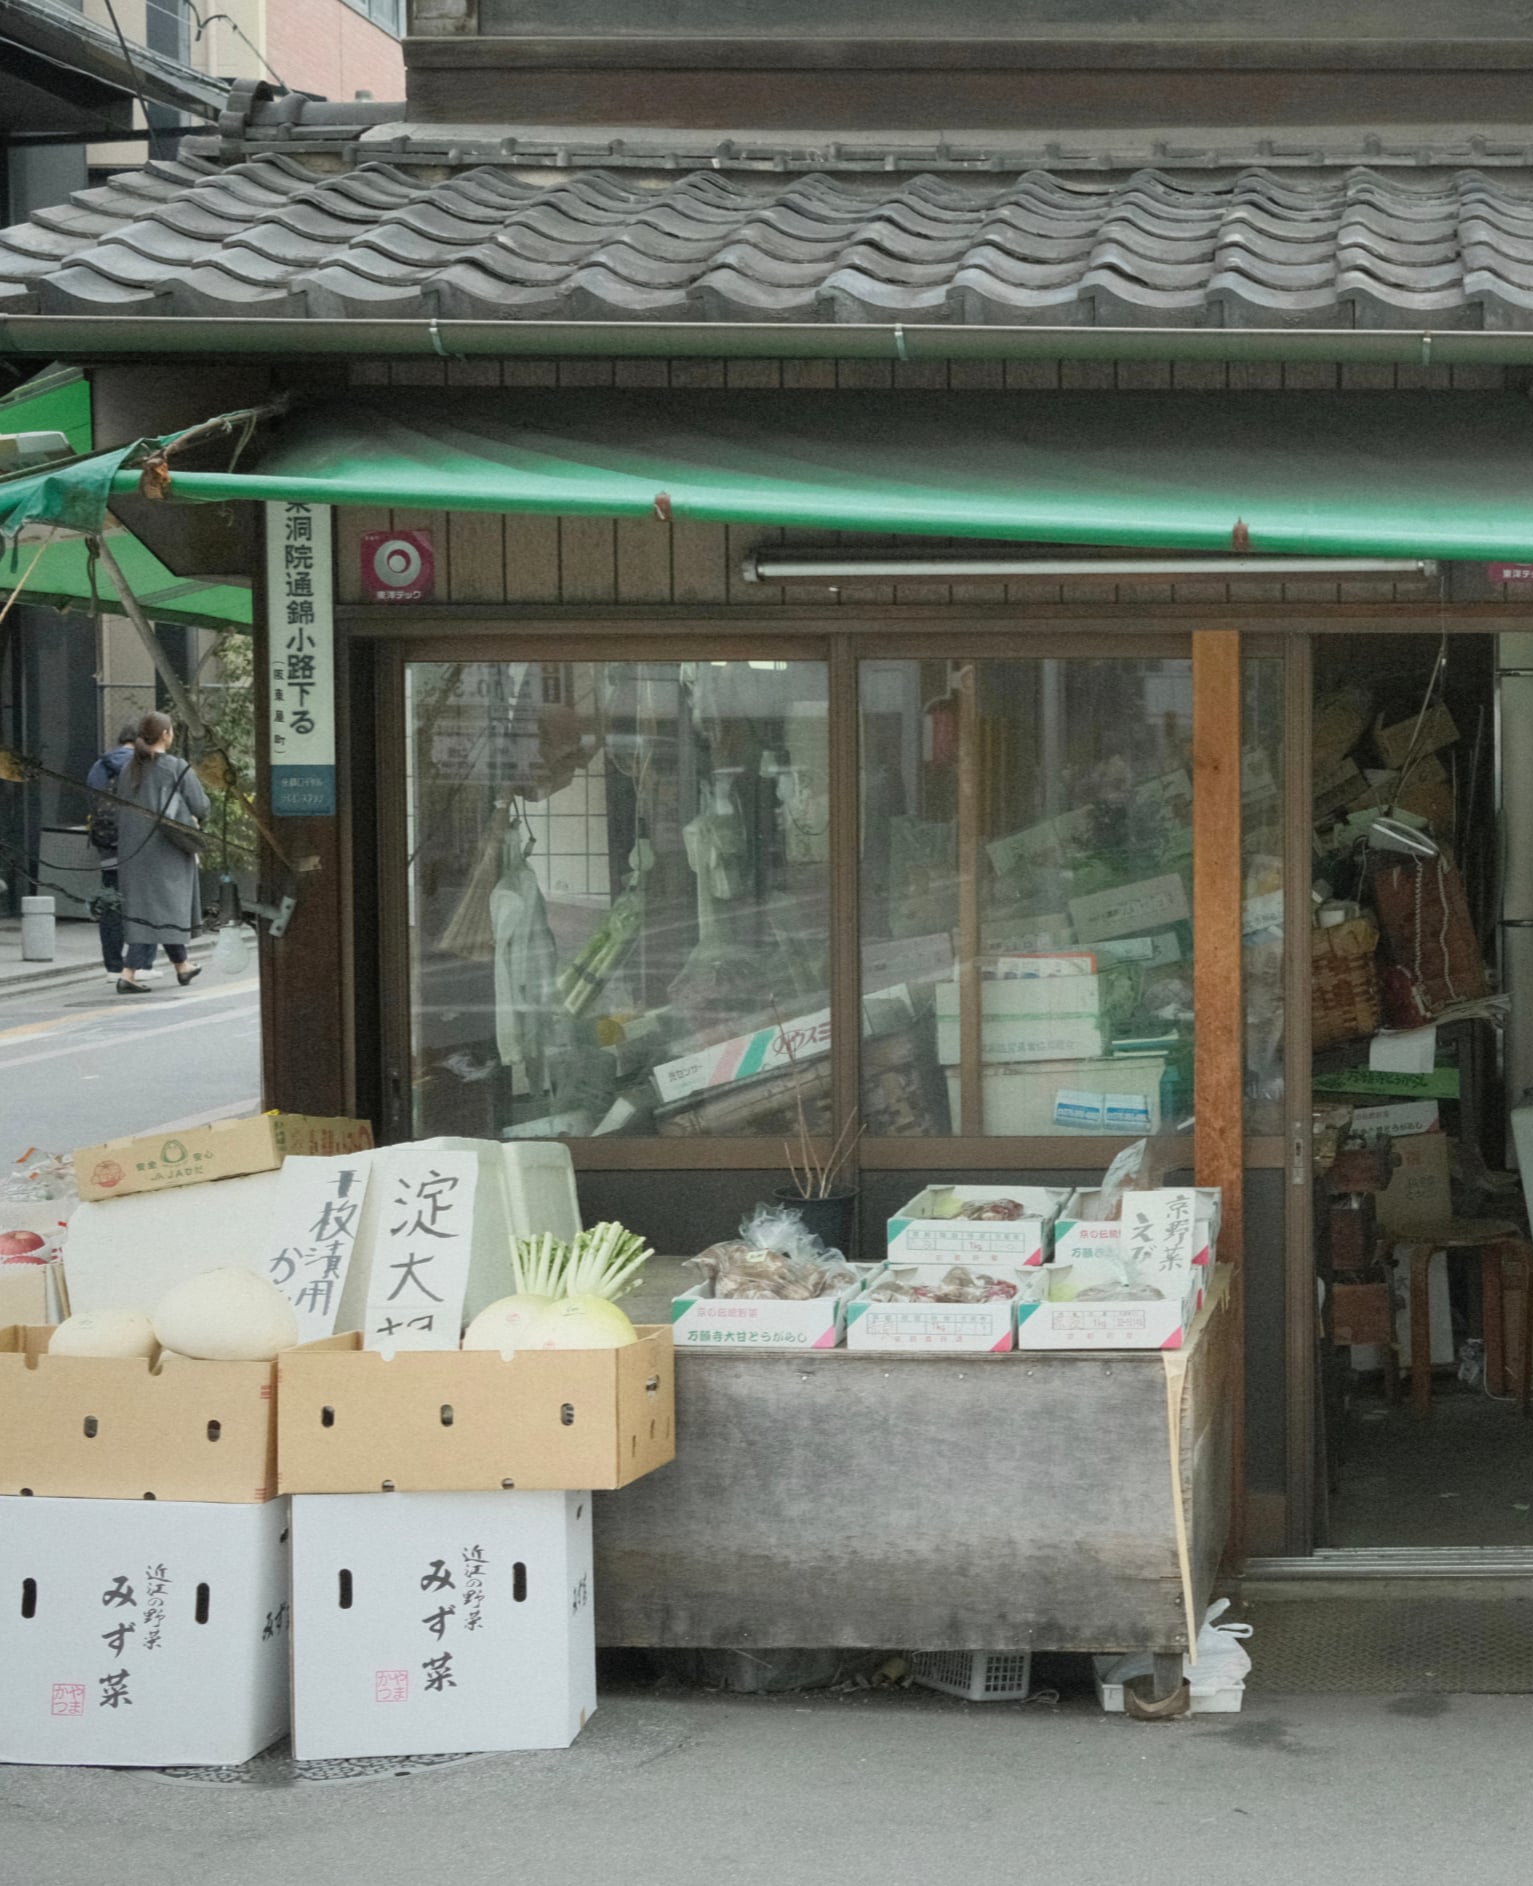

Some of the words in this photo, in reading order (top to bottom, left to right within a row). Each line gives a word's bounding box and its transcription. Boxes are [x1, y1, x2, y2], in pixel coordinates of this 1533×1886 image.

[269, 1247, 303, 1302] か
[1079, 1229, 1121, 1240] 京の伝統
[1158, 1194, 1191, 1273] 京野菜
[143, 1563, 173, 1651] 近江の野菜
[420, 1559, 457, 1692] みず菜
[462, 1544, 490, 1632] 近江の野菜
[98, 1575, 138, 1709] みず菜
